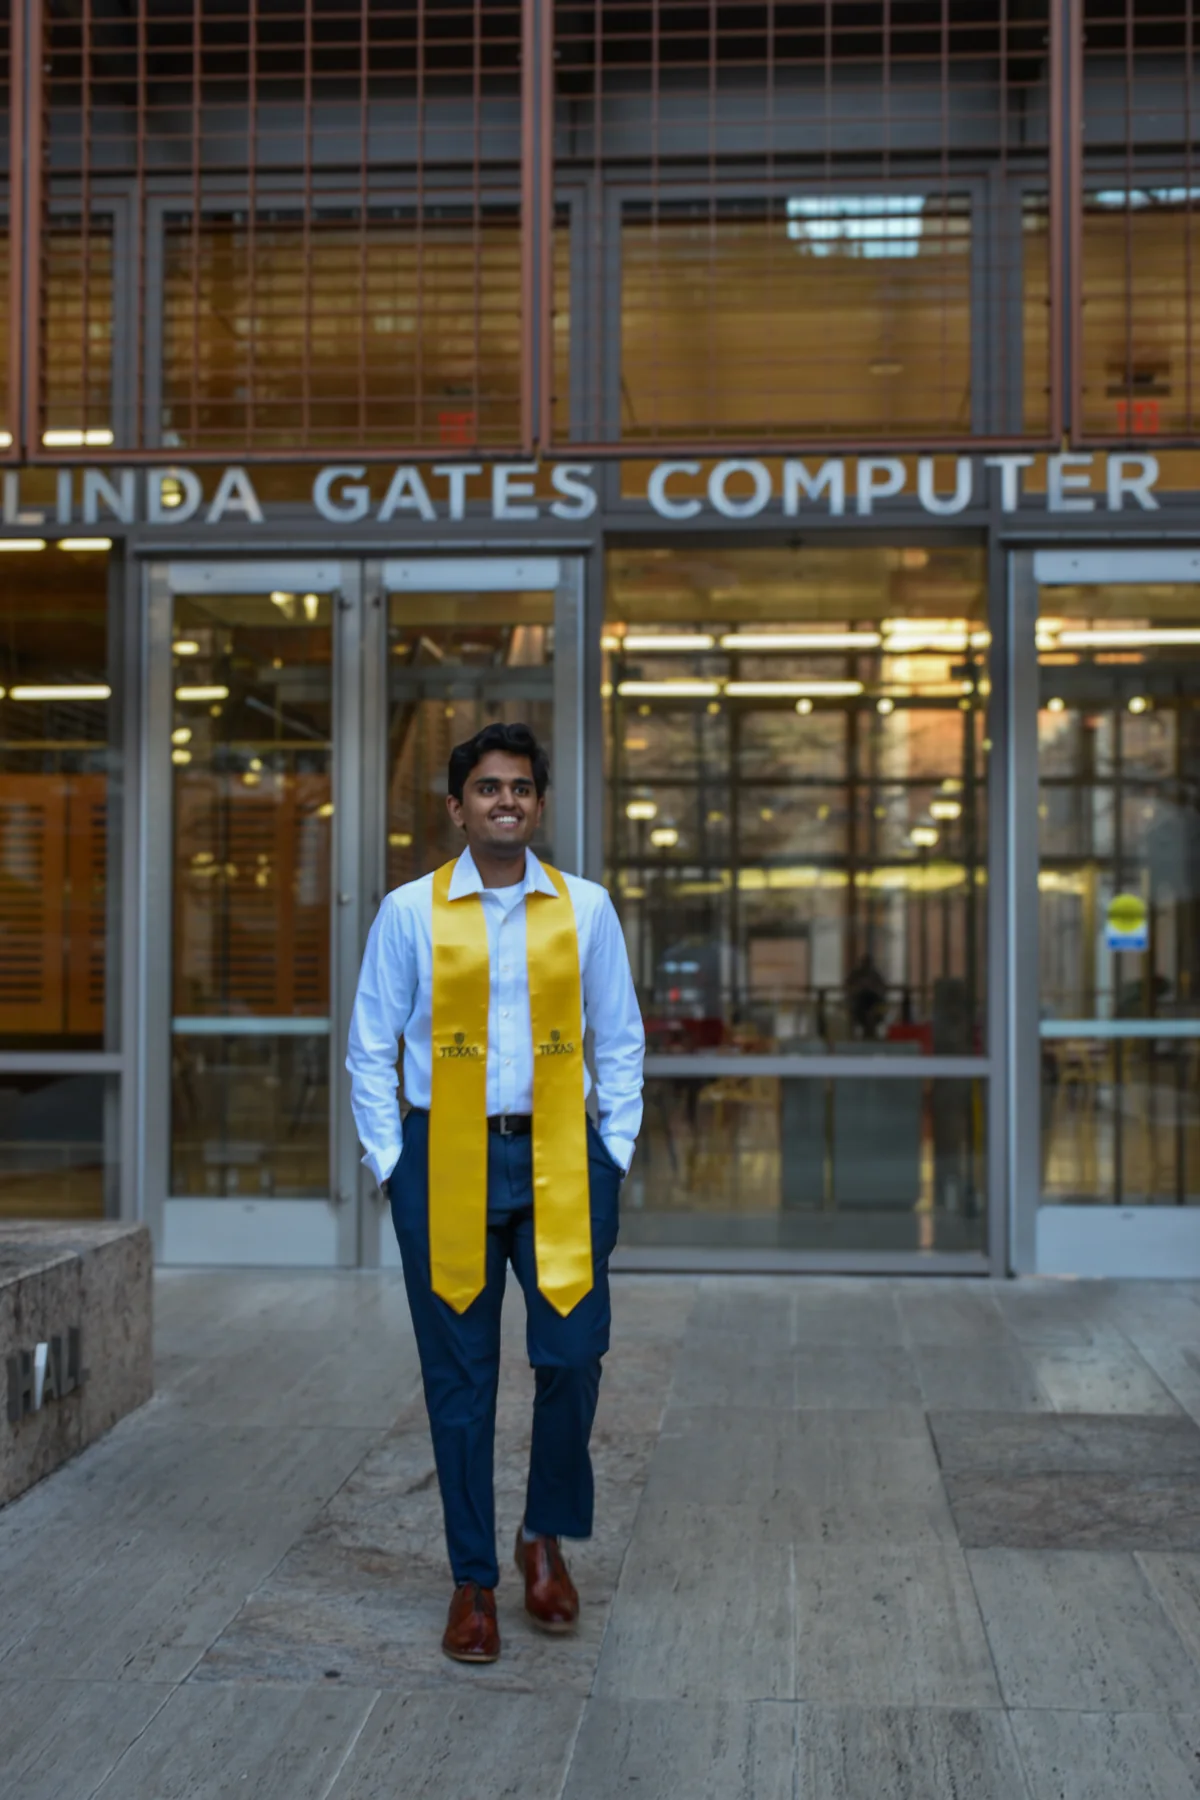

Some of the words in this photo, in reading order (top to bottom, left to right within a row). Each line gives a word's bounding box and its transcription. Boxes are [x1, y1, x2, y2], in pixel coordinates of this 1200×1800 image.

[312, 464, 598, 523] GATES
[647, 453, 1161, 519] COMPUTER
[439, 1045, 479, 1058] TEXAS
[539, 1042, 574, 1056] TEXAS
